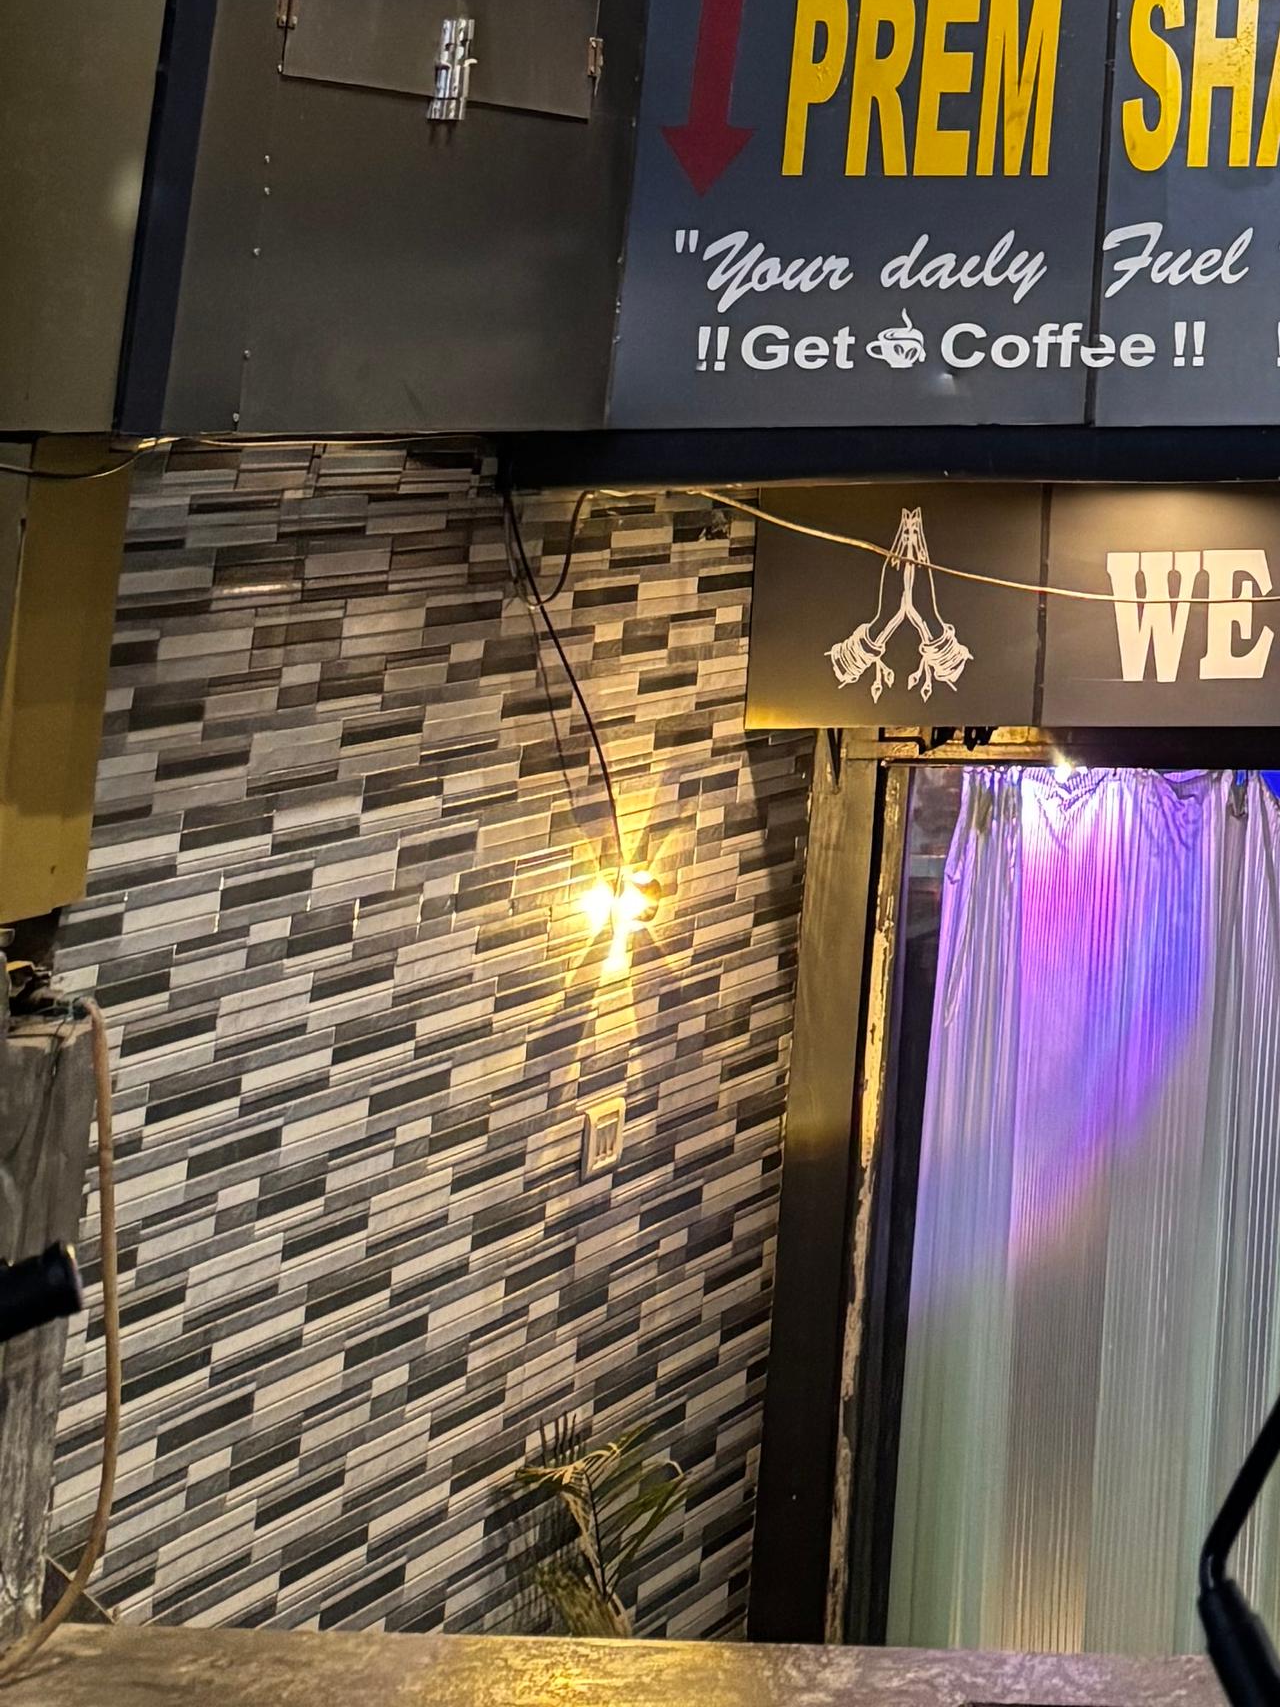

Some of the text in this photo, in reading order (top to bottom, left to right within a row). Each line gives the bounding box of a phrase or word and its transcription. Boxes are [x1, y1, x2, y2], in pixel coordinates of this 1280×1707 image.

[880, 235, 1046, 300] daily
[1102, 222, 1249, 300] Fuel
[939, 320, 1156, 372] Coffee
